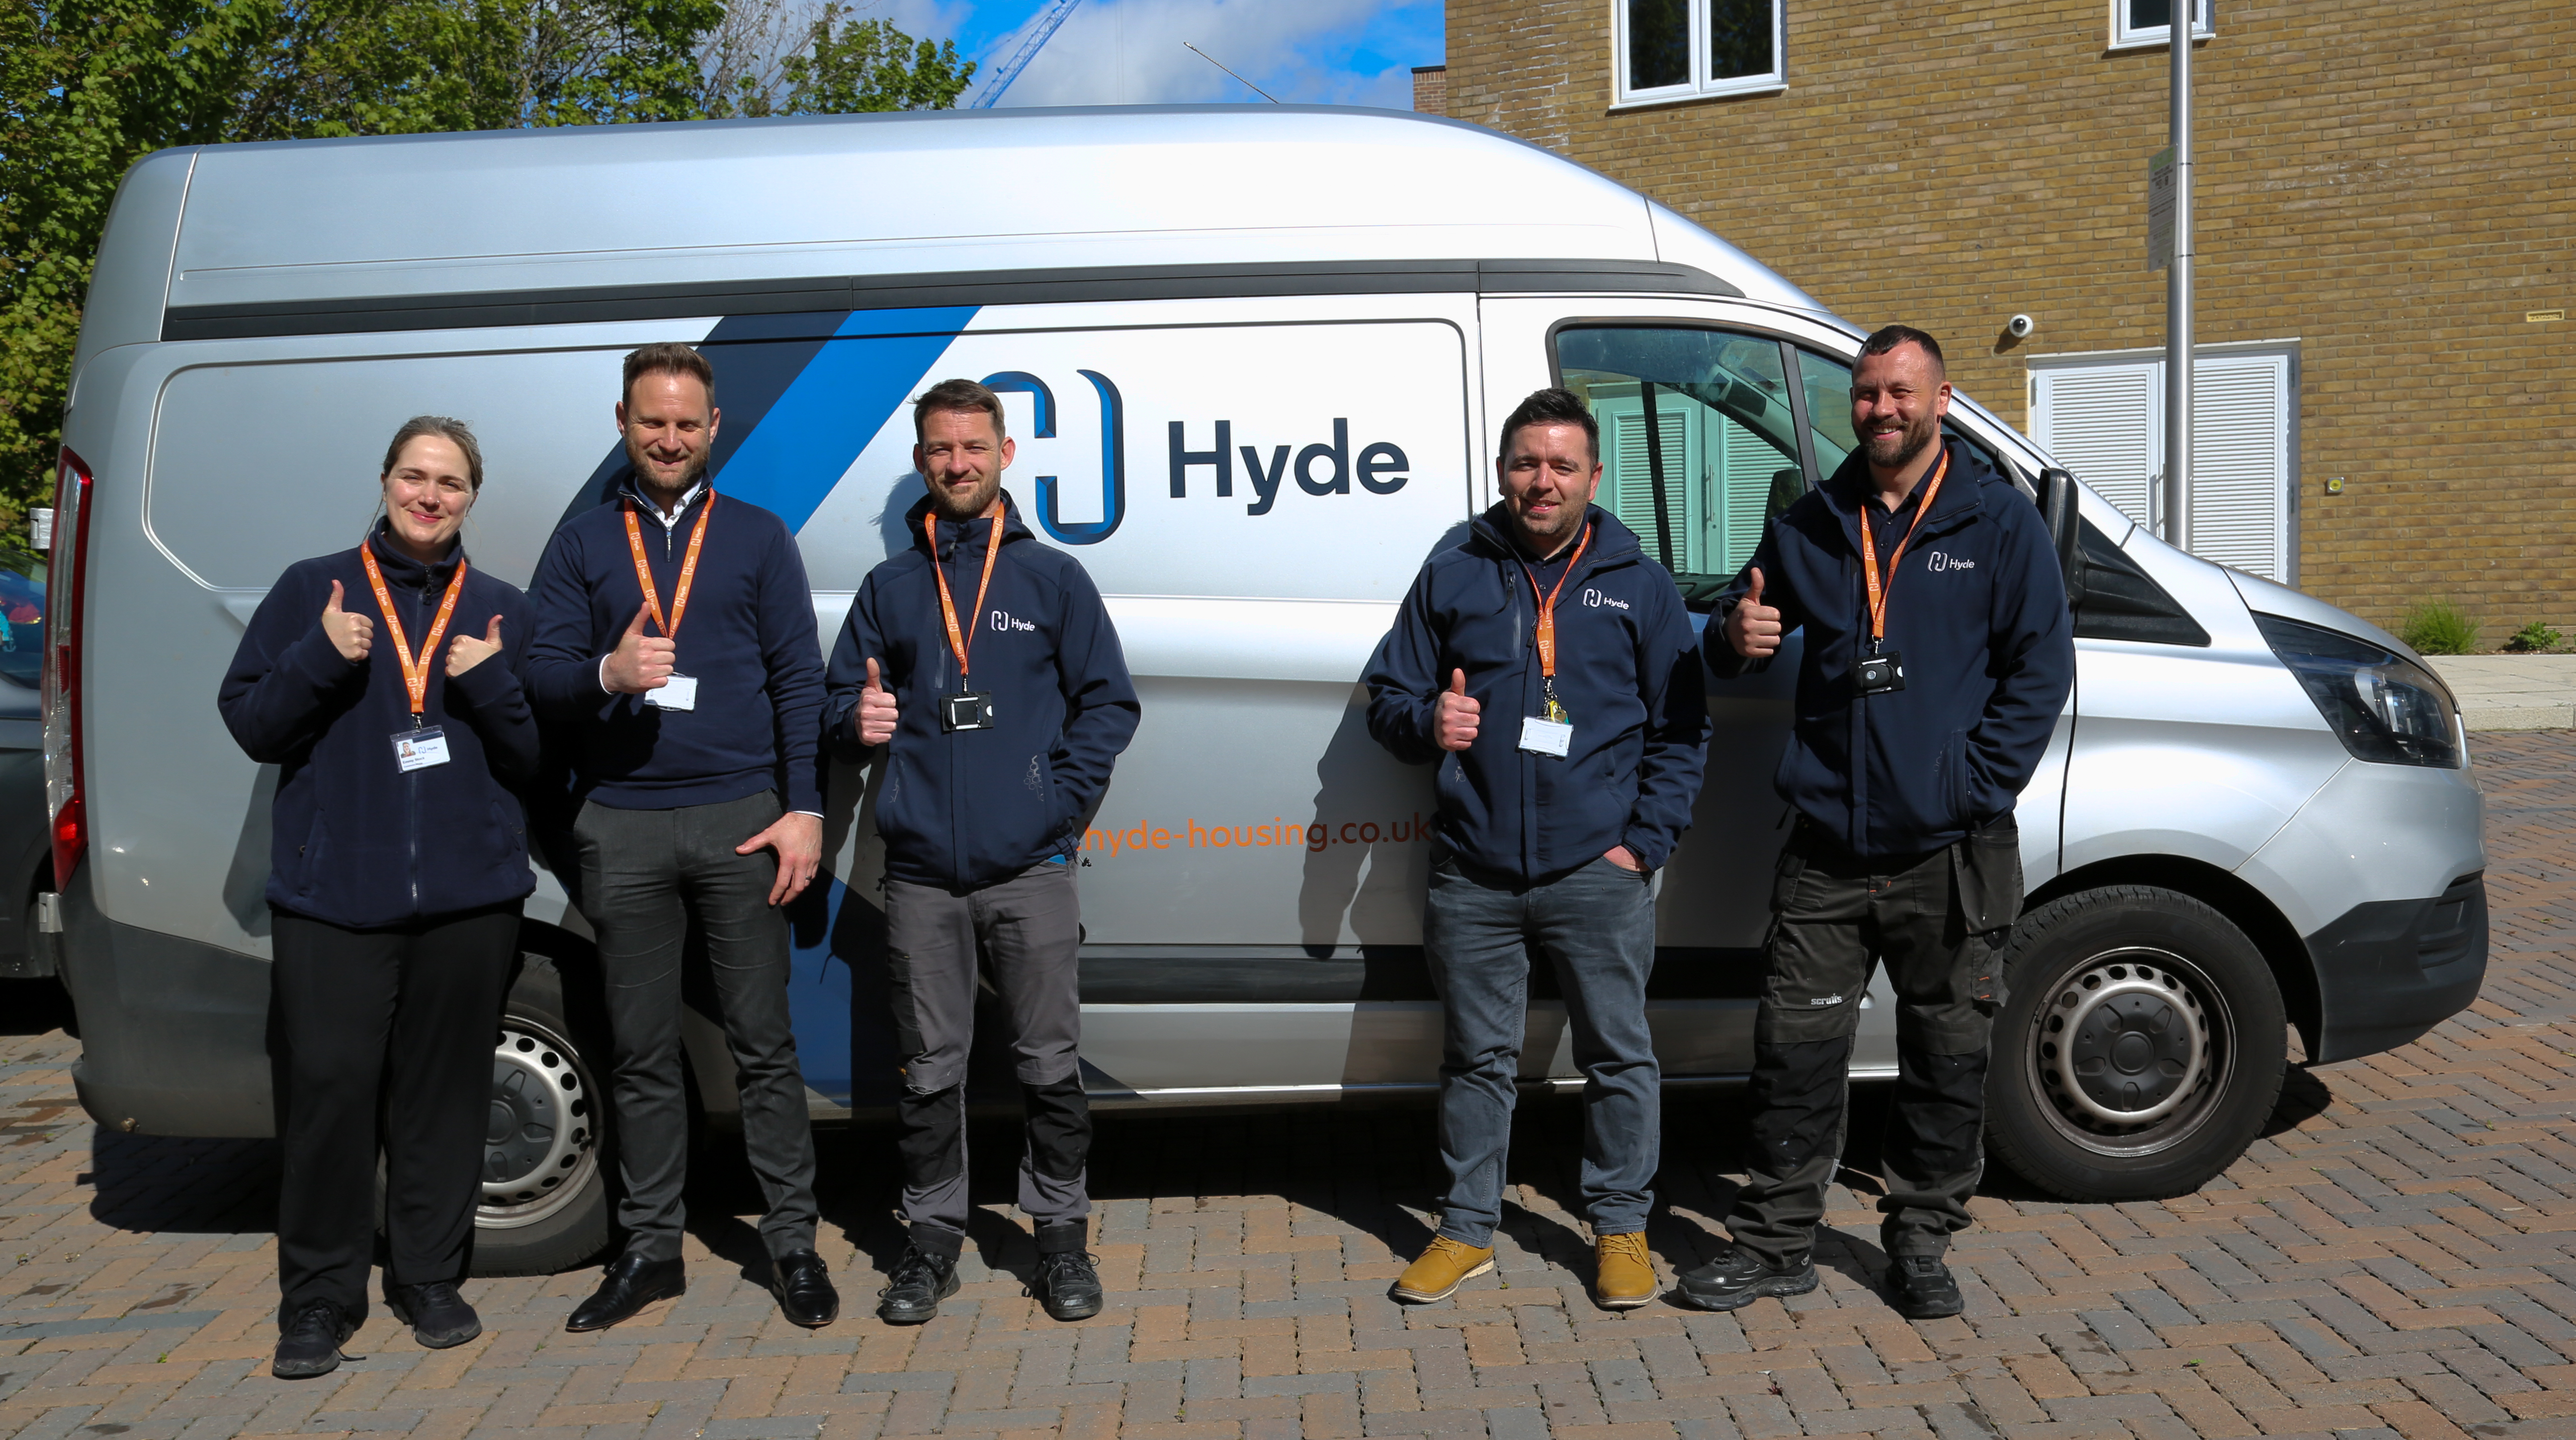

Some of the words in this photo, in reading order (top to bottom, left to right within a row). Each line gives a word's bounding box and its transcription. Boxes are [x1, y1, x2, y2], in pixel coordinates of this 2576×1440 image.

[1168, 417, 1410, 516] Hyde
[1950, 558, 1975, 570] Hyde
[1604, 597, 1629, 610] Hyde
[437, 618, 445, 629] Hyde
[1012, 618, 1035, 631] Hyde
